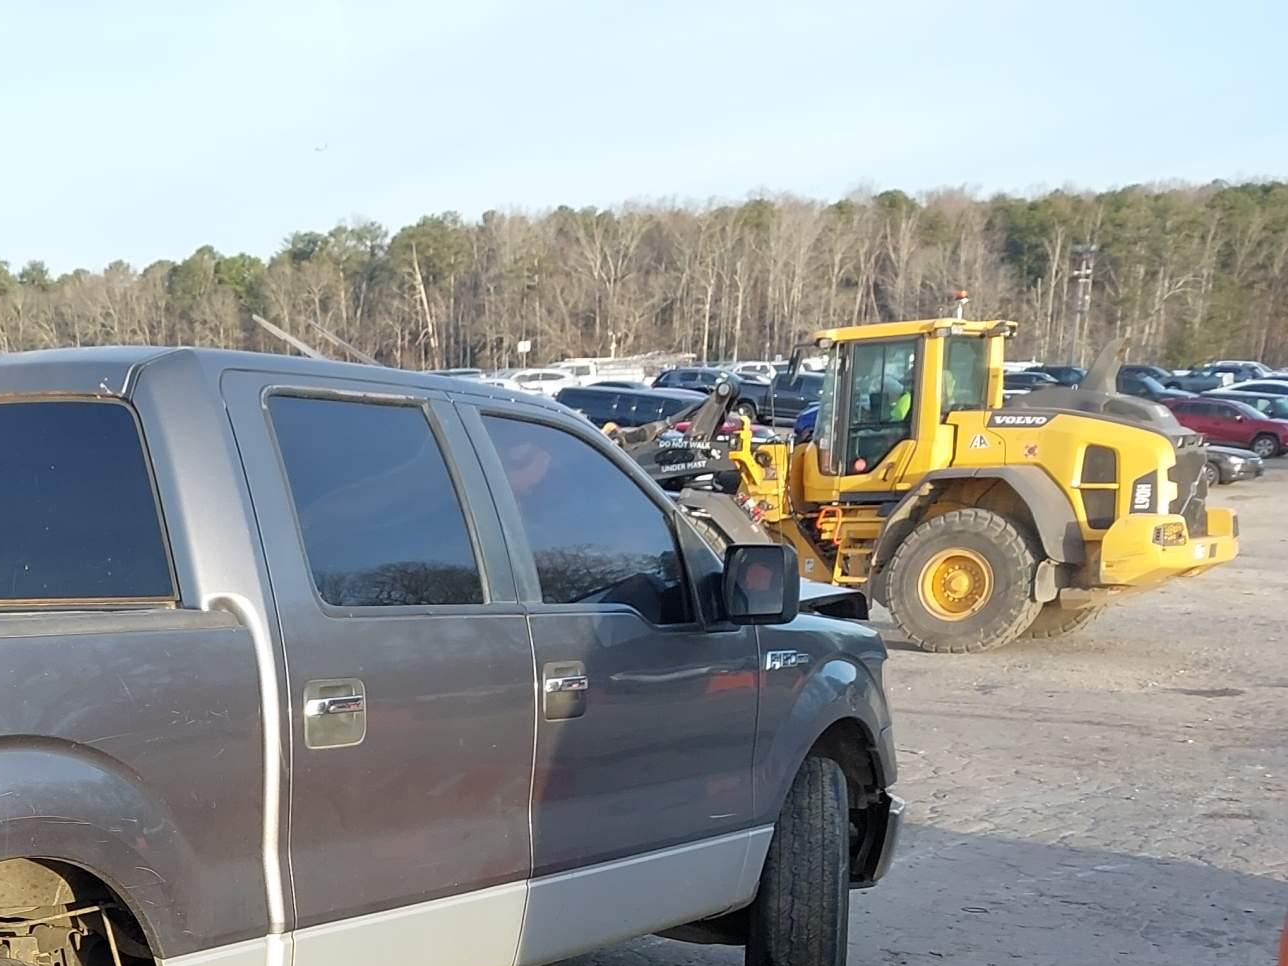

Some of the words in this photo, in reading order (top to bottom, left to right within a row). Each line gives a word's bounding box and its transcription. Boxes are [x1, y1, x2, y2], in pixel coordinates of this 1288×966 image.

[994, 415, 1048, 425] VOLVO
[659, 440, 671, 448] DO
[672, 440, 688, 449] NOT
[689, 440, 710, 449] WALK
[661, 463, 686, 472] UNDER
[687, 460, 707, 470] MAST
[1133, 483, 1152, 510] L90H
